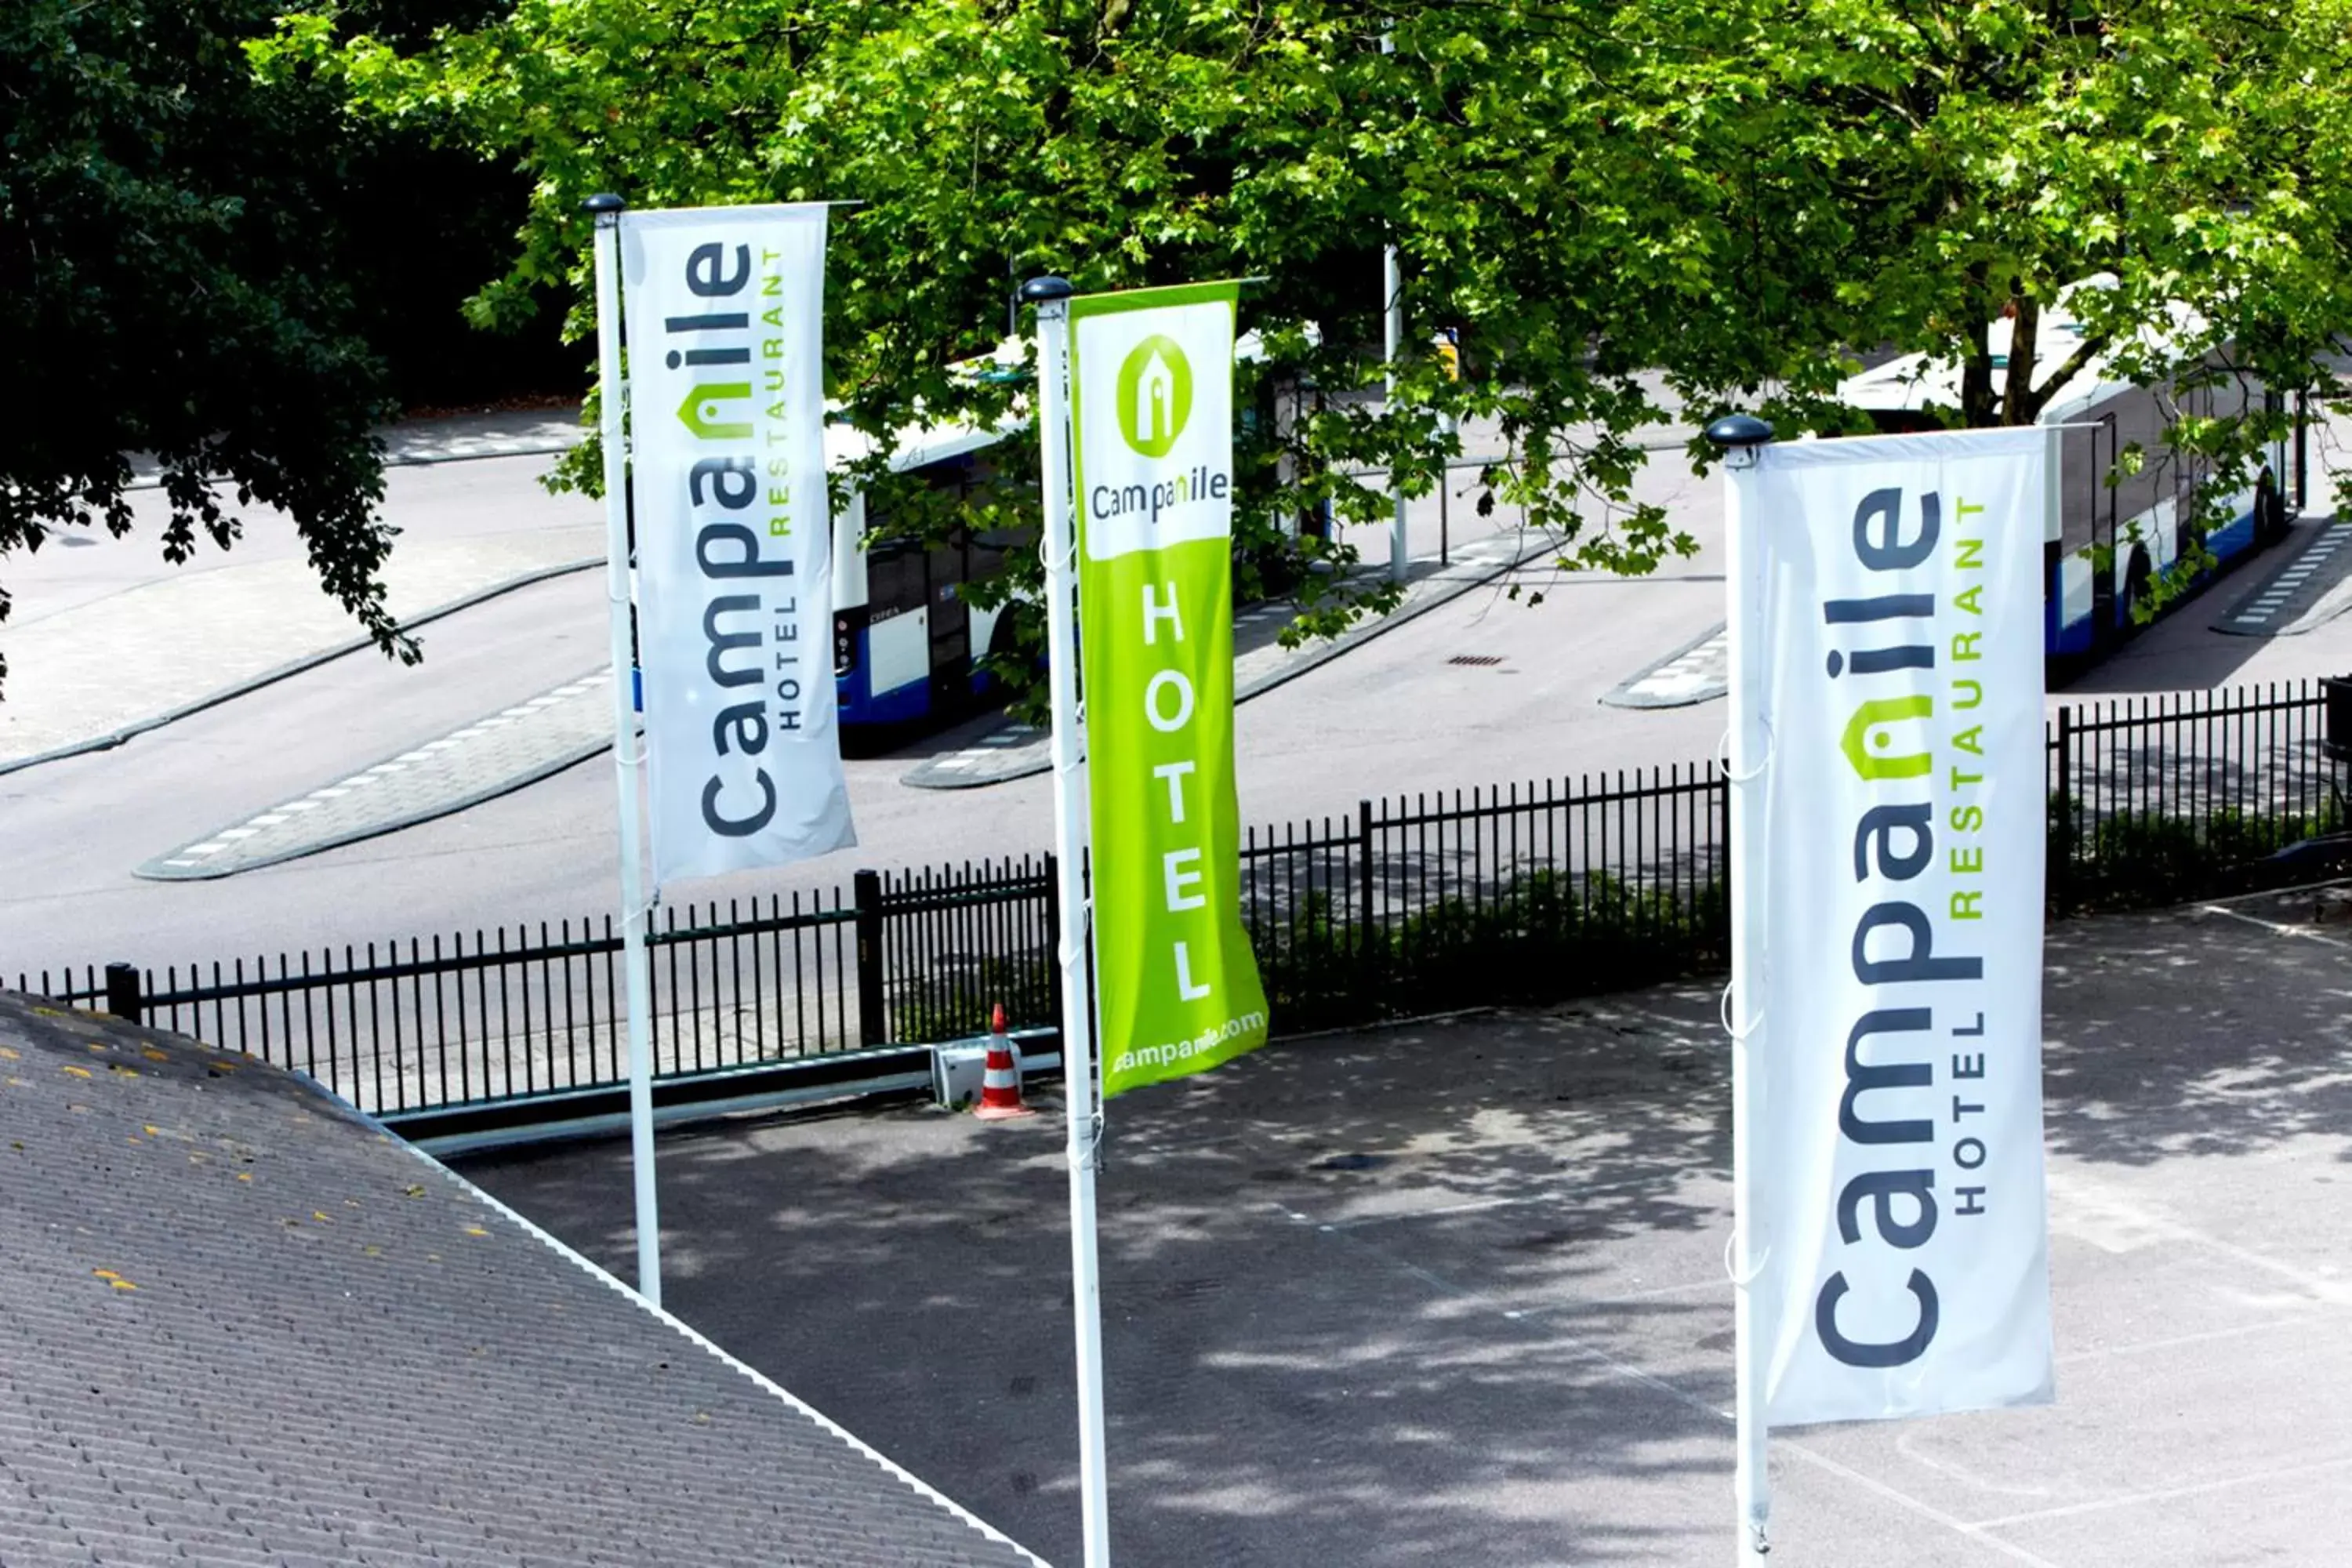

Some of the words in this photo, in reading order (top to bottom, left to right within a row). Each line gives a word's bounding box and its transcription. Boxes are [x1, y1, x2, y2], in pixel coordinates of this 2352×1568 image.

[762, 249, 792, 536] RESTAURANT
[1092, 466, 1228, 523] Campanile
[665, 241, 793, 837] Campanile
[775, 597, 800, 731] HOTEL
[1142, 581, 1210, 1002] HOTEL
[1950, 496, 1985, 920] RESTAURANT
[1112, 1009, 1265, 1073] campan.com
[1815, 486, 1984, 1368] Campanile
[1951, 1012, 1987, 1216] HOTEL
